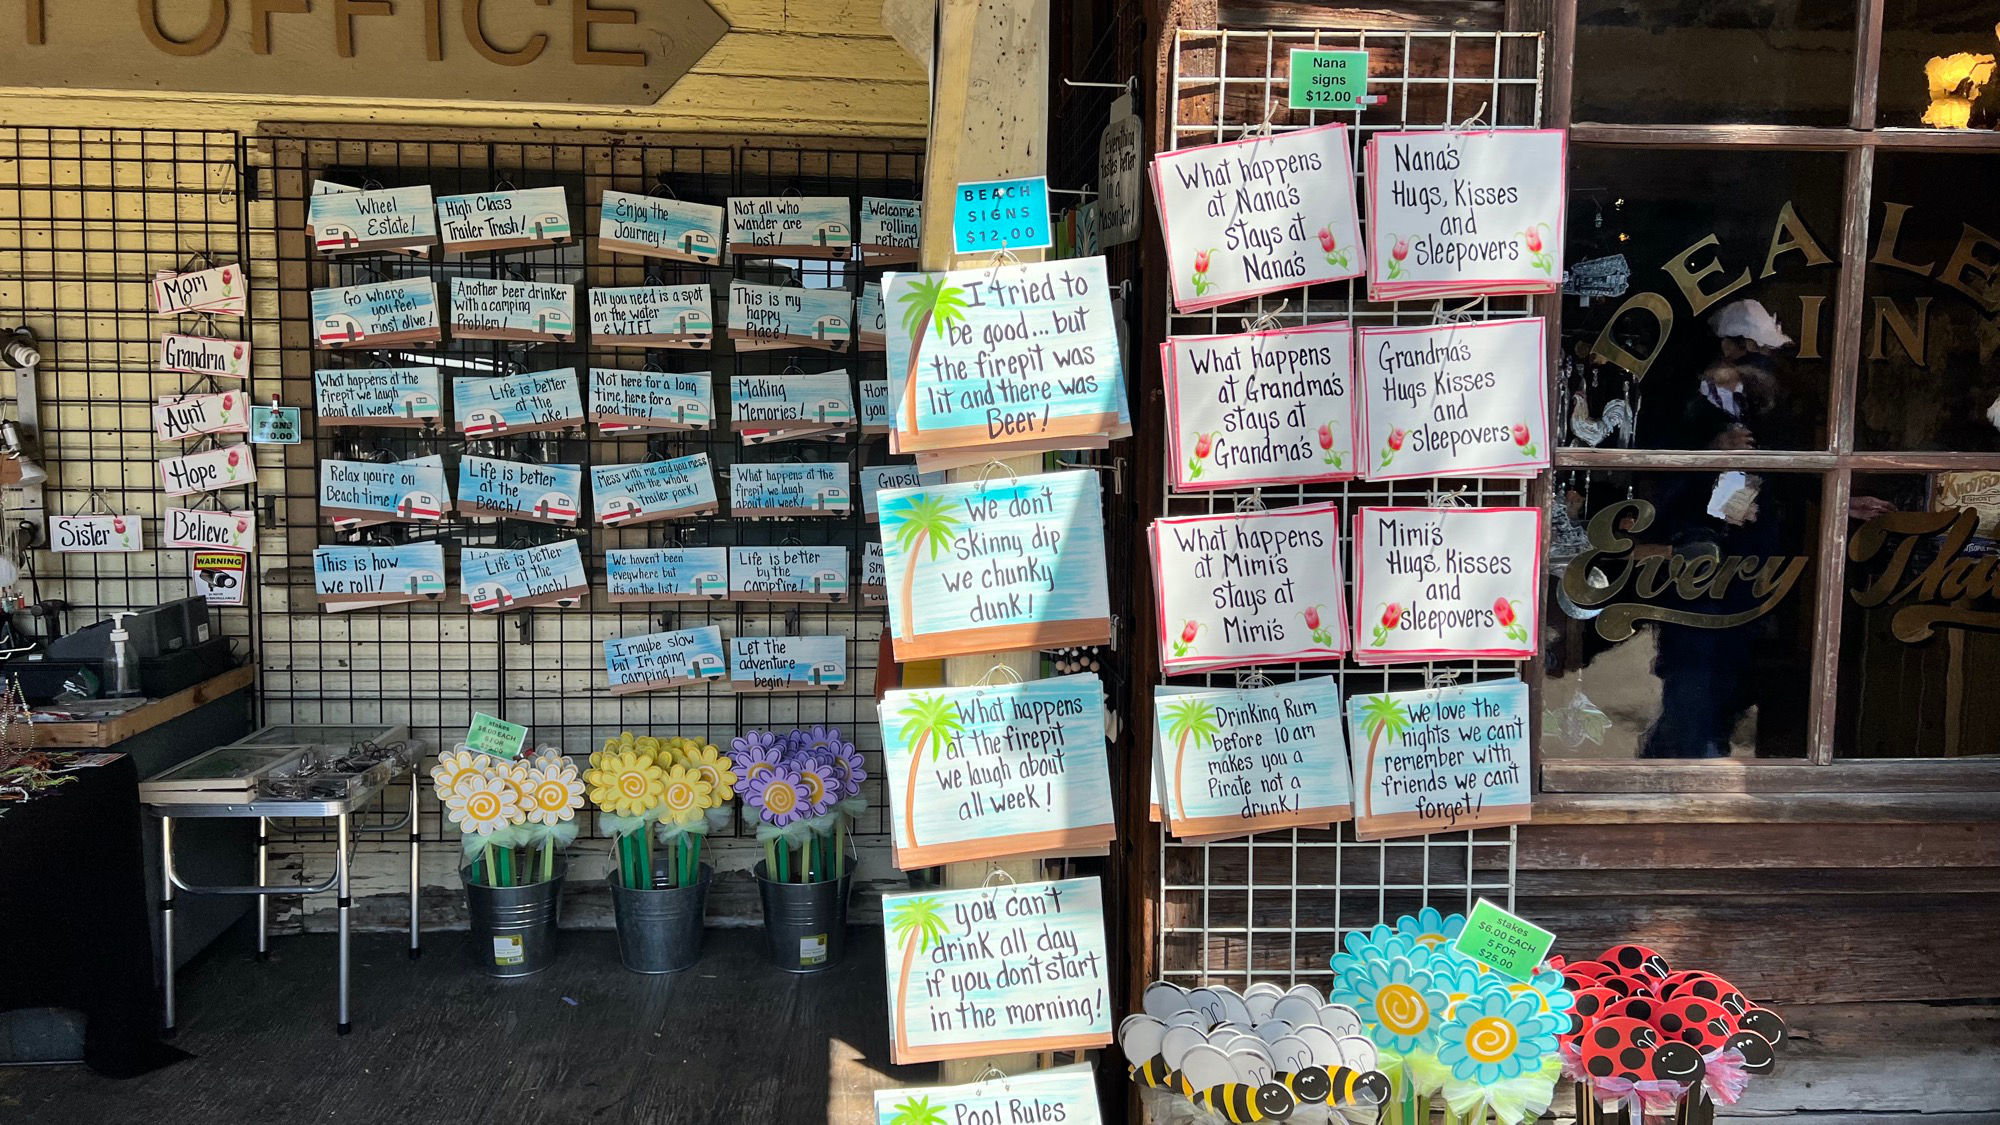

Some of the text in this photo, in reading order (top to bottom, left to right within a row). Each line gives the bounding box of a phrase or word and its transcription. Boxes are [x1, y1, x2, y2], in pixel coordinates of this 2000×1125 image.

[1313, 58, 1346, 68] Nana
[1312, 74, 1346, 87] signs
[1306, 90, 1351, 102] $12.00
[1394, 143, 1460, 172] Nana's
[356, 196, 397, 215] Wheel
[964, 185, 1031, 202] BEACH
[1392, 179, 1518, 215] Hugs, Kisses
[446, 196, 512, 221] High Class
[616, 198, 669, 222] Enjoy the
[734, 200, 800, 215] Not all who
[968, 207, 1031, 222] SIGNS
[368, 215, 416, 236] Estate!
[444, 215, 526, 241] Trailer Trash!
[614, 220, 667, 244] Journey!
[782, 220, 802, 230] are
[1440, 207, 1477, 236] and
[752, 231, 783, 248] lost!
[966, 227, 1035, 244] $12.00
[163, 274, 208, 311] Mom
[344, 287, 404, 305] Go where
[457, 280, 567, 302] Another beer drinker
[593, 287, 704, 310] All you need is a spot
[733, 287, 801, 312] This is my
[962, 270, 1089, 308] I tried to
[371, 311, 433, 334] most alive!
[594, 306, 660, 322] on the water
[746, 304, 781, 326] happy
[614, 319, 653, 336] WIFI
[1795, 295, 1934, 367] IN
[165, 337, 226, 371] Grandma
[929, 343, 1096, 383] the firepit was
[1189, 346, 1331, 374] What happens
[489, 377, 567, 401] Life is better
[738, 379, 787, 400] Making
[928, 374, 1099, 416] lit and there was
[1218, 371, 1344, 404] at Grandma's
[515, 395, 553, 411] at the
[737, 403, 805, 422] Memories!
[1287, 401, 1306, 428] at
[163, 400, 207, 437] Aunt
[986, 404, 1049, 440] Beer!
[1215, 433, 1313, 469] Grandma's
[169, 460, 218, 489] Hope
[469, 459, 557, 487] Life is better
[479, 481, 519, 498] at the
[475, 495, 522, 516] Beach!
[964, 485, 1054, 522] We don't
[59, 520, 110, 548] Sister
[173, 511, 230, 545] Believe
[1031, 522, 1061, 554] dip
[1379, 518, 1444, 547] Mimi's
[196, 556, 243, 567] WARNING
[316, 552, 399, 572] This is how
[981, 556, 1055, 592] chunky
[1387, 548, 1512, 582] Hugs, Kisses
[1562, 499, 1809, 642] Every
[322, 580, 344, 594] we
[1426, 574, 1461, 601] and
[969, 592, 1033, 623] dunk!
[738, 639, 786, 656] Let the
[739, 658, 796, 670] adventure
[753, 674, 792, 691] begin!
[1005, 886, 1063, 917] can't
[1478, 921, 1536, 954] $6.00 EACH
[1497, 918, 1529, 937] stakes
[931, 923, 1078, 964] drink all day
[1487, 939, 1517, 958] 5 FOR
[1479, 948, 1513, 969] $25.00
[926, 950, 1101, 1002] if you don't start
[930, 988, 1102, 1032] in the morning!
[954, 1099, 1066, 1125] Pool Rules
